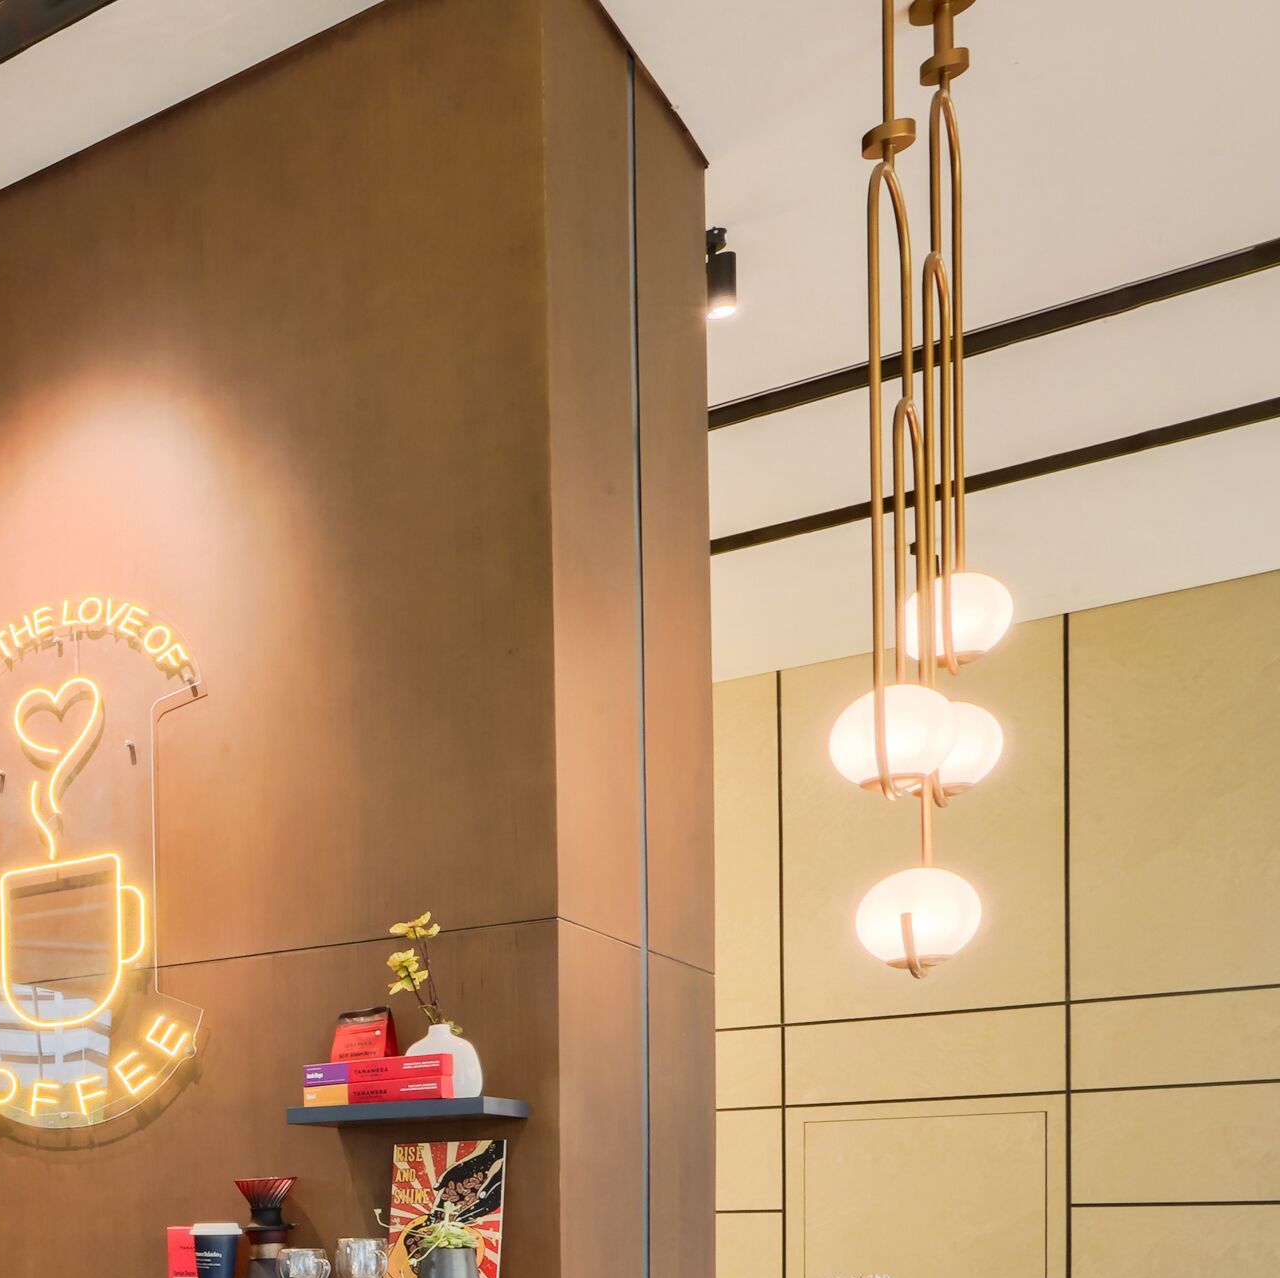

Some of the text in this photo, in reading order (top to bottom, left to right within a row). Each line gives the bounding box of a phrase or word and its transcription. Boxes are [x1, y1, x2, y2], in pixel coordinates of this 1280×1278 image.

[61, 597, 150, 637] LOVE
[143, 625, 189, 667] OF
[396, 1146, 424, 1162] RISE
[395, 1169, 416, 1182] AND
[393, 1188, 431, 1204] SHINE
